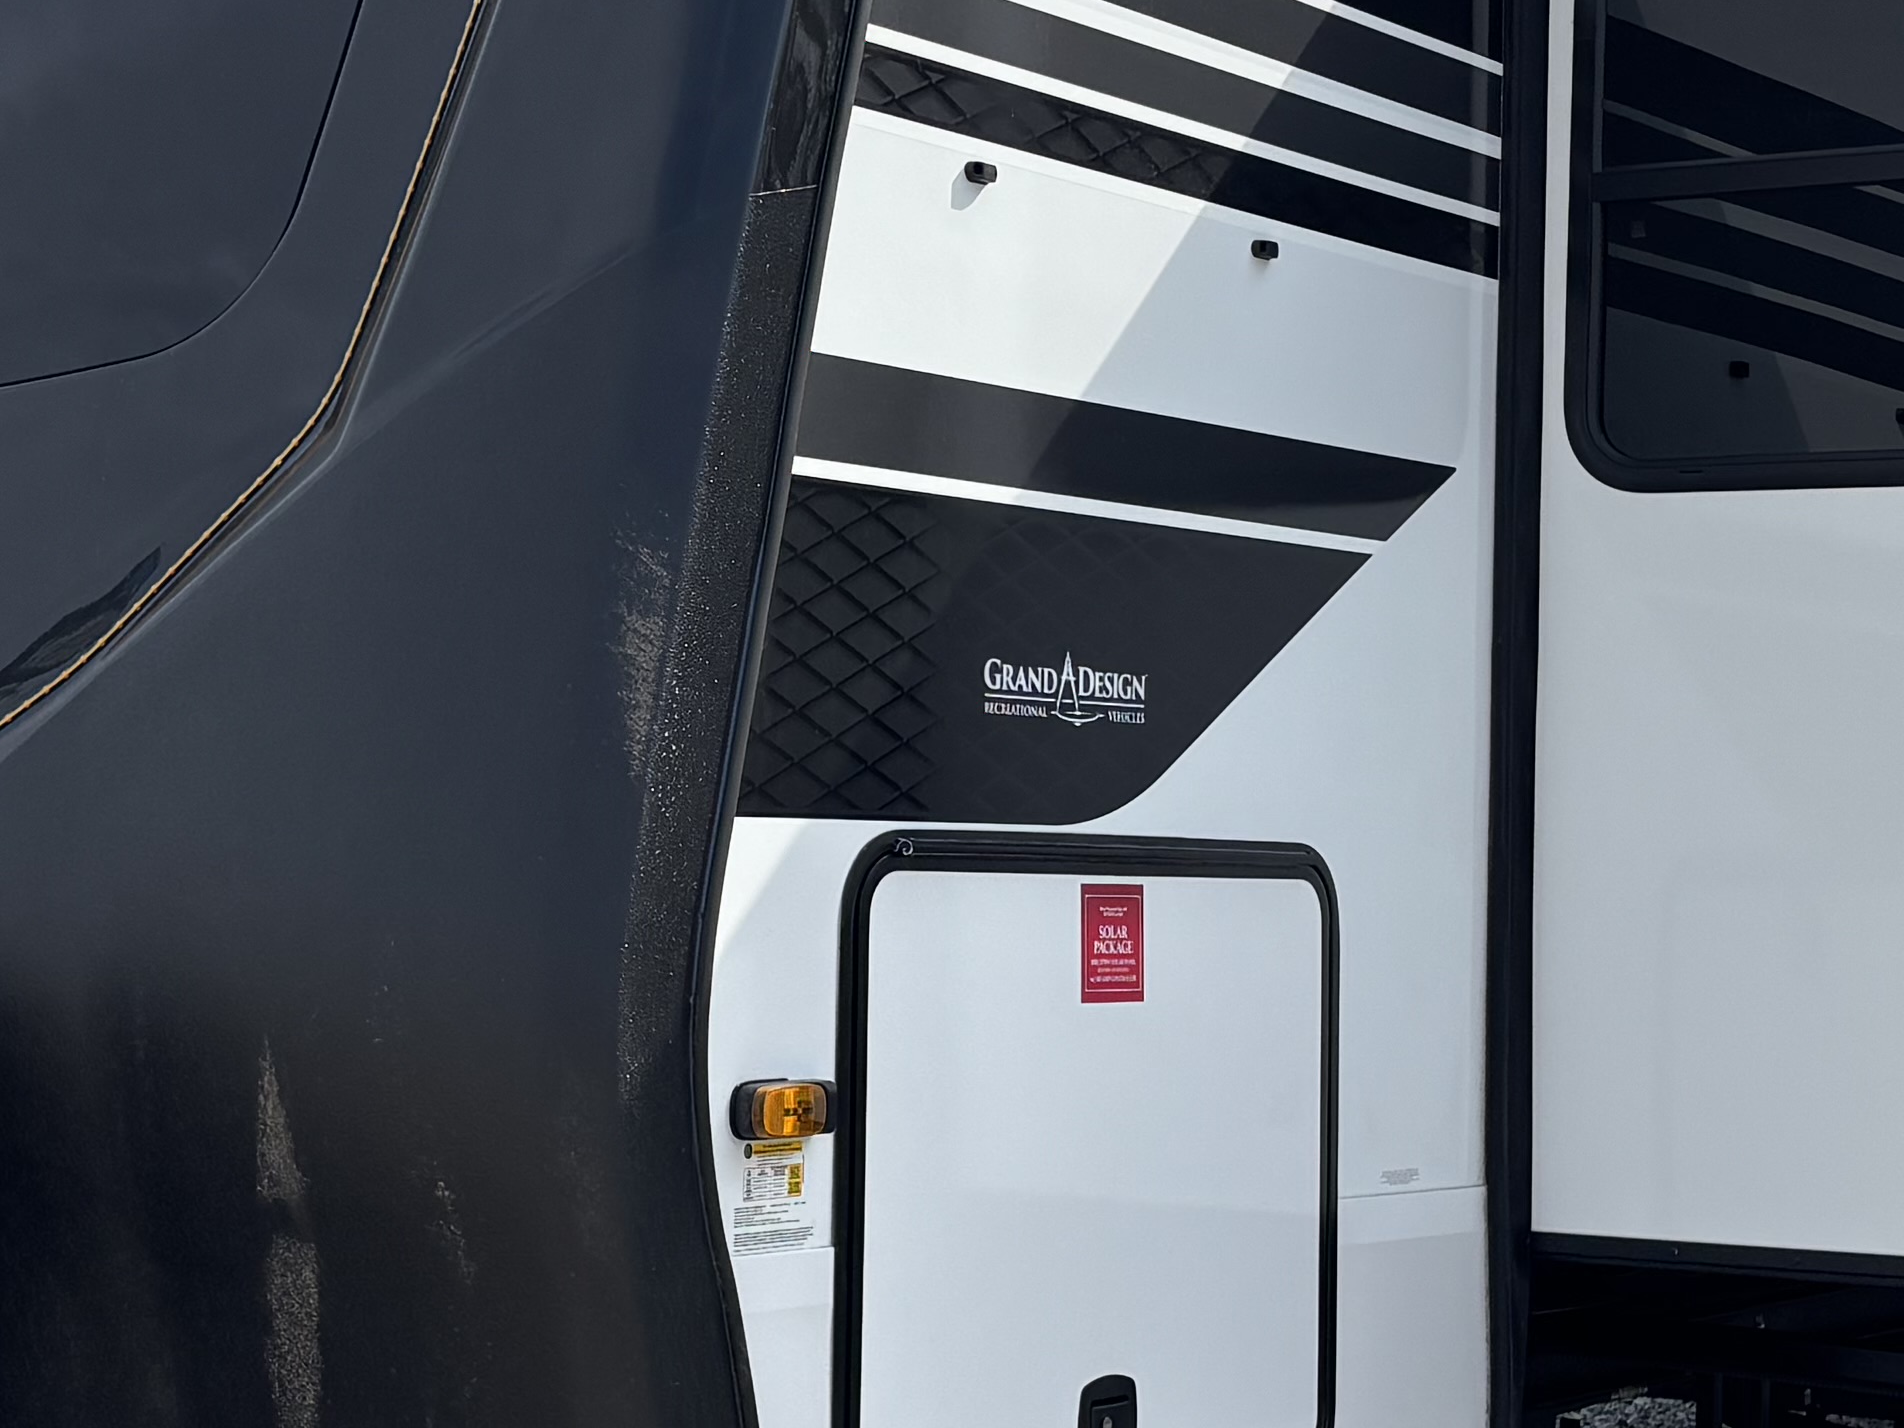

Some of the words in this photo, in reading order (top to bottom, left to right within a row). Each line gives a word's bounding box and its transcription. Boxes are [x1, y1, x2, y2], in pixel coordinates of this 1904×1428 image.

[984, 658, 1058, 694] GRAND
[1077, 666, 1146, 701] DESIGN
[984, 701, 1048, 718] RECREATIONAL
[1107, 710, 1146, 724] VEHICLES
[1099, 925, 1128, 939] SOLAR
[1093, 940, 1135, 955] PACKAGE
